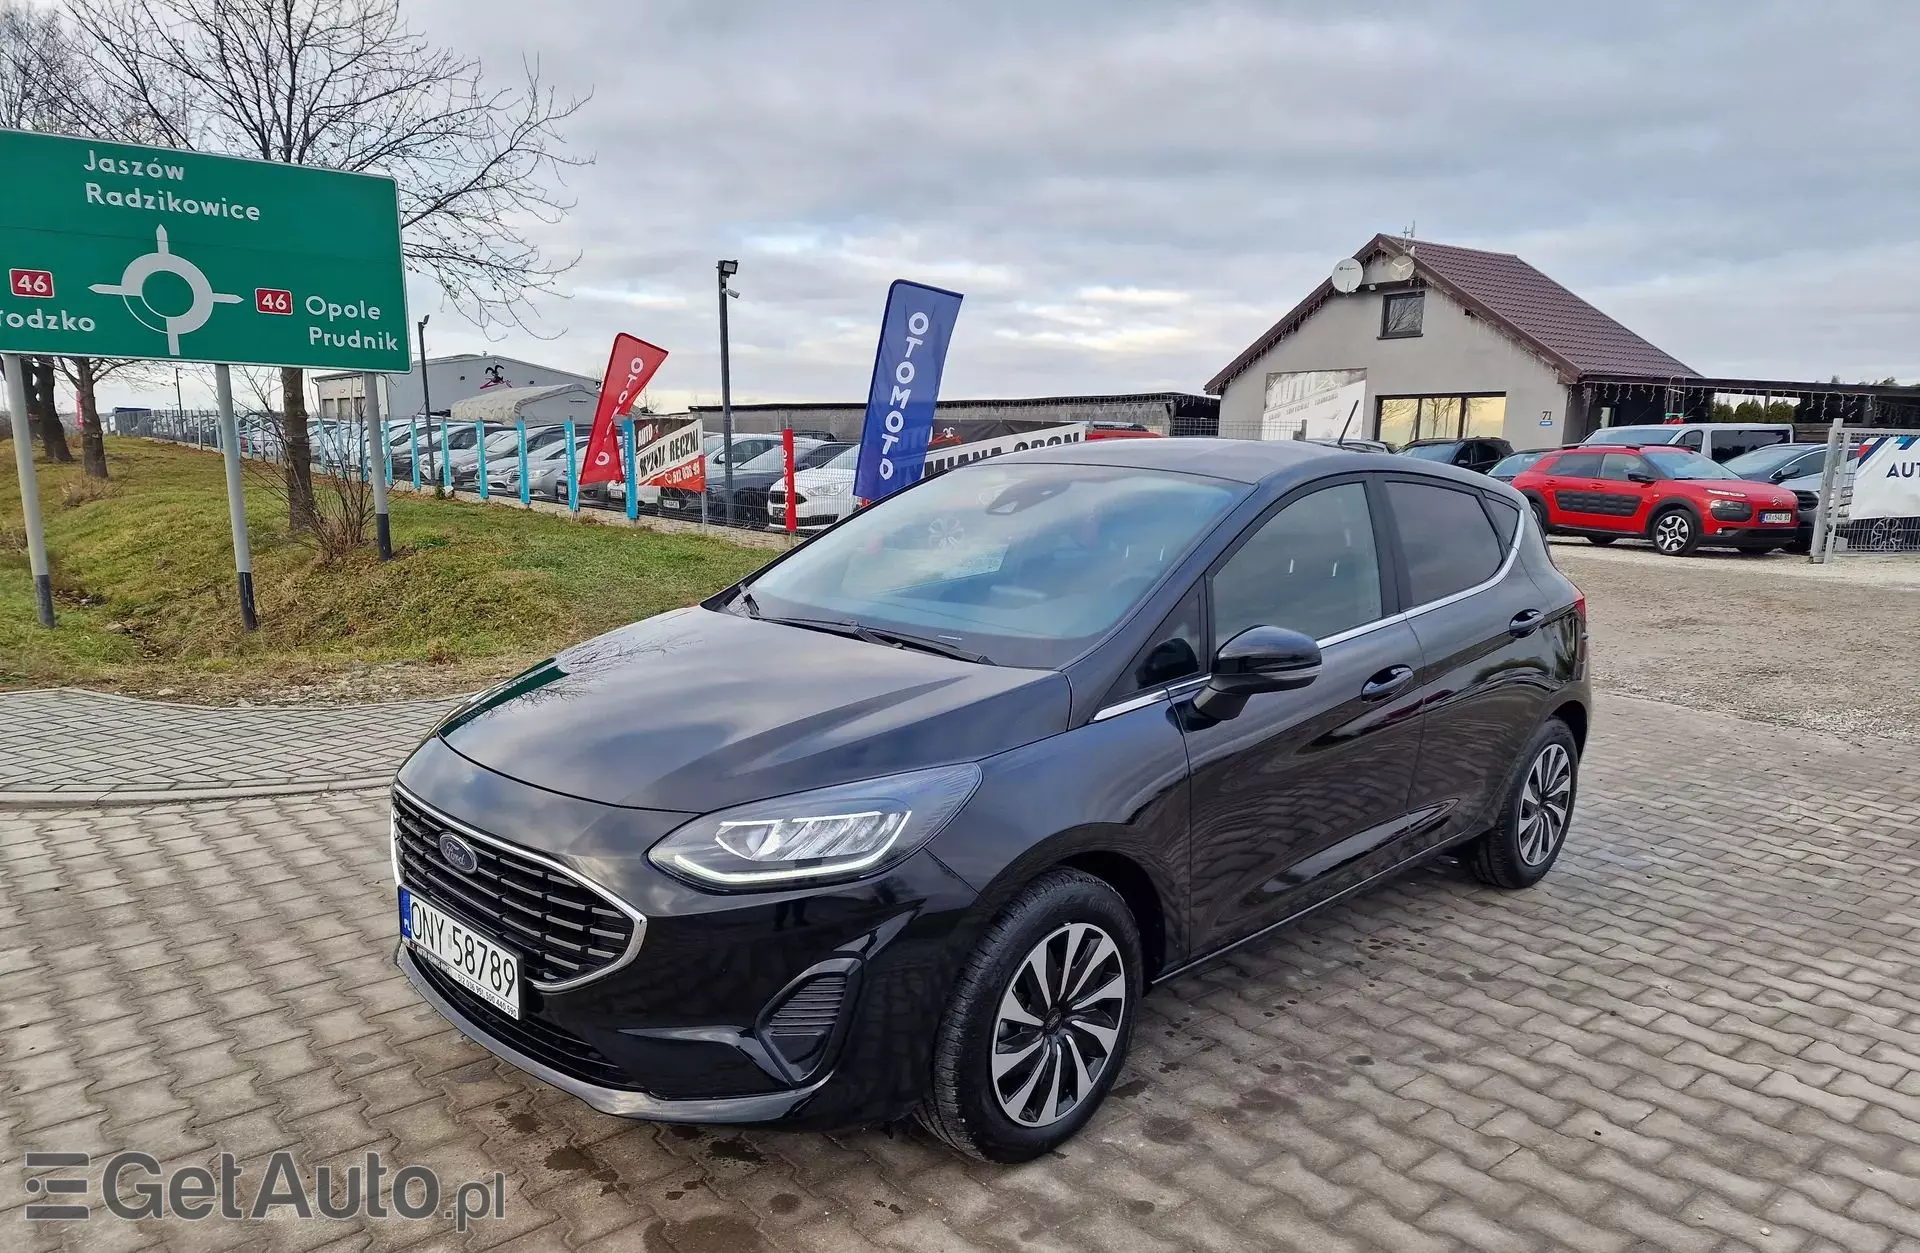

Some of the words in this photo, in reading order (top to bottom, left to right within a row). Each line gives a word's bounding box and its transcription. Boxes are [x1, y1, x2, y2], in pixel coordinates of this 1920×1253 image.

[83, 149, 185, 181] Jaszów
[85, 182, 261, 221] Radzikowice
[17, 274, 48, 293] 46
[260, 292, 288, 312] 46
[305, 295, 382, 323] Opole
[308, 326, 399, 352] Prudnik
[879, 311, 929, 481] OTOMOTO
[1542, 410, 1552, 420] 71
[445, 842, 466, 866] Ford
[411, 901, 445, 954] ONY
[452, 929, 516, 998] 58789
